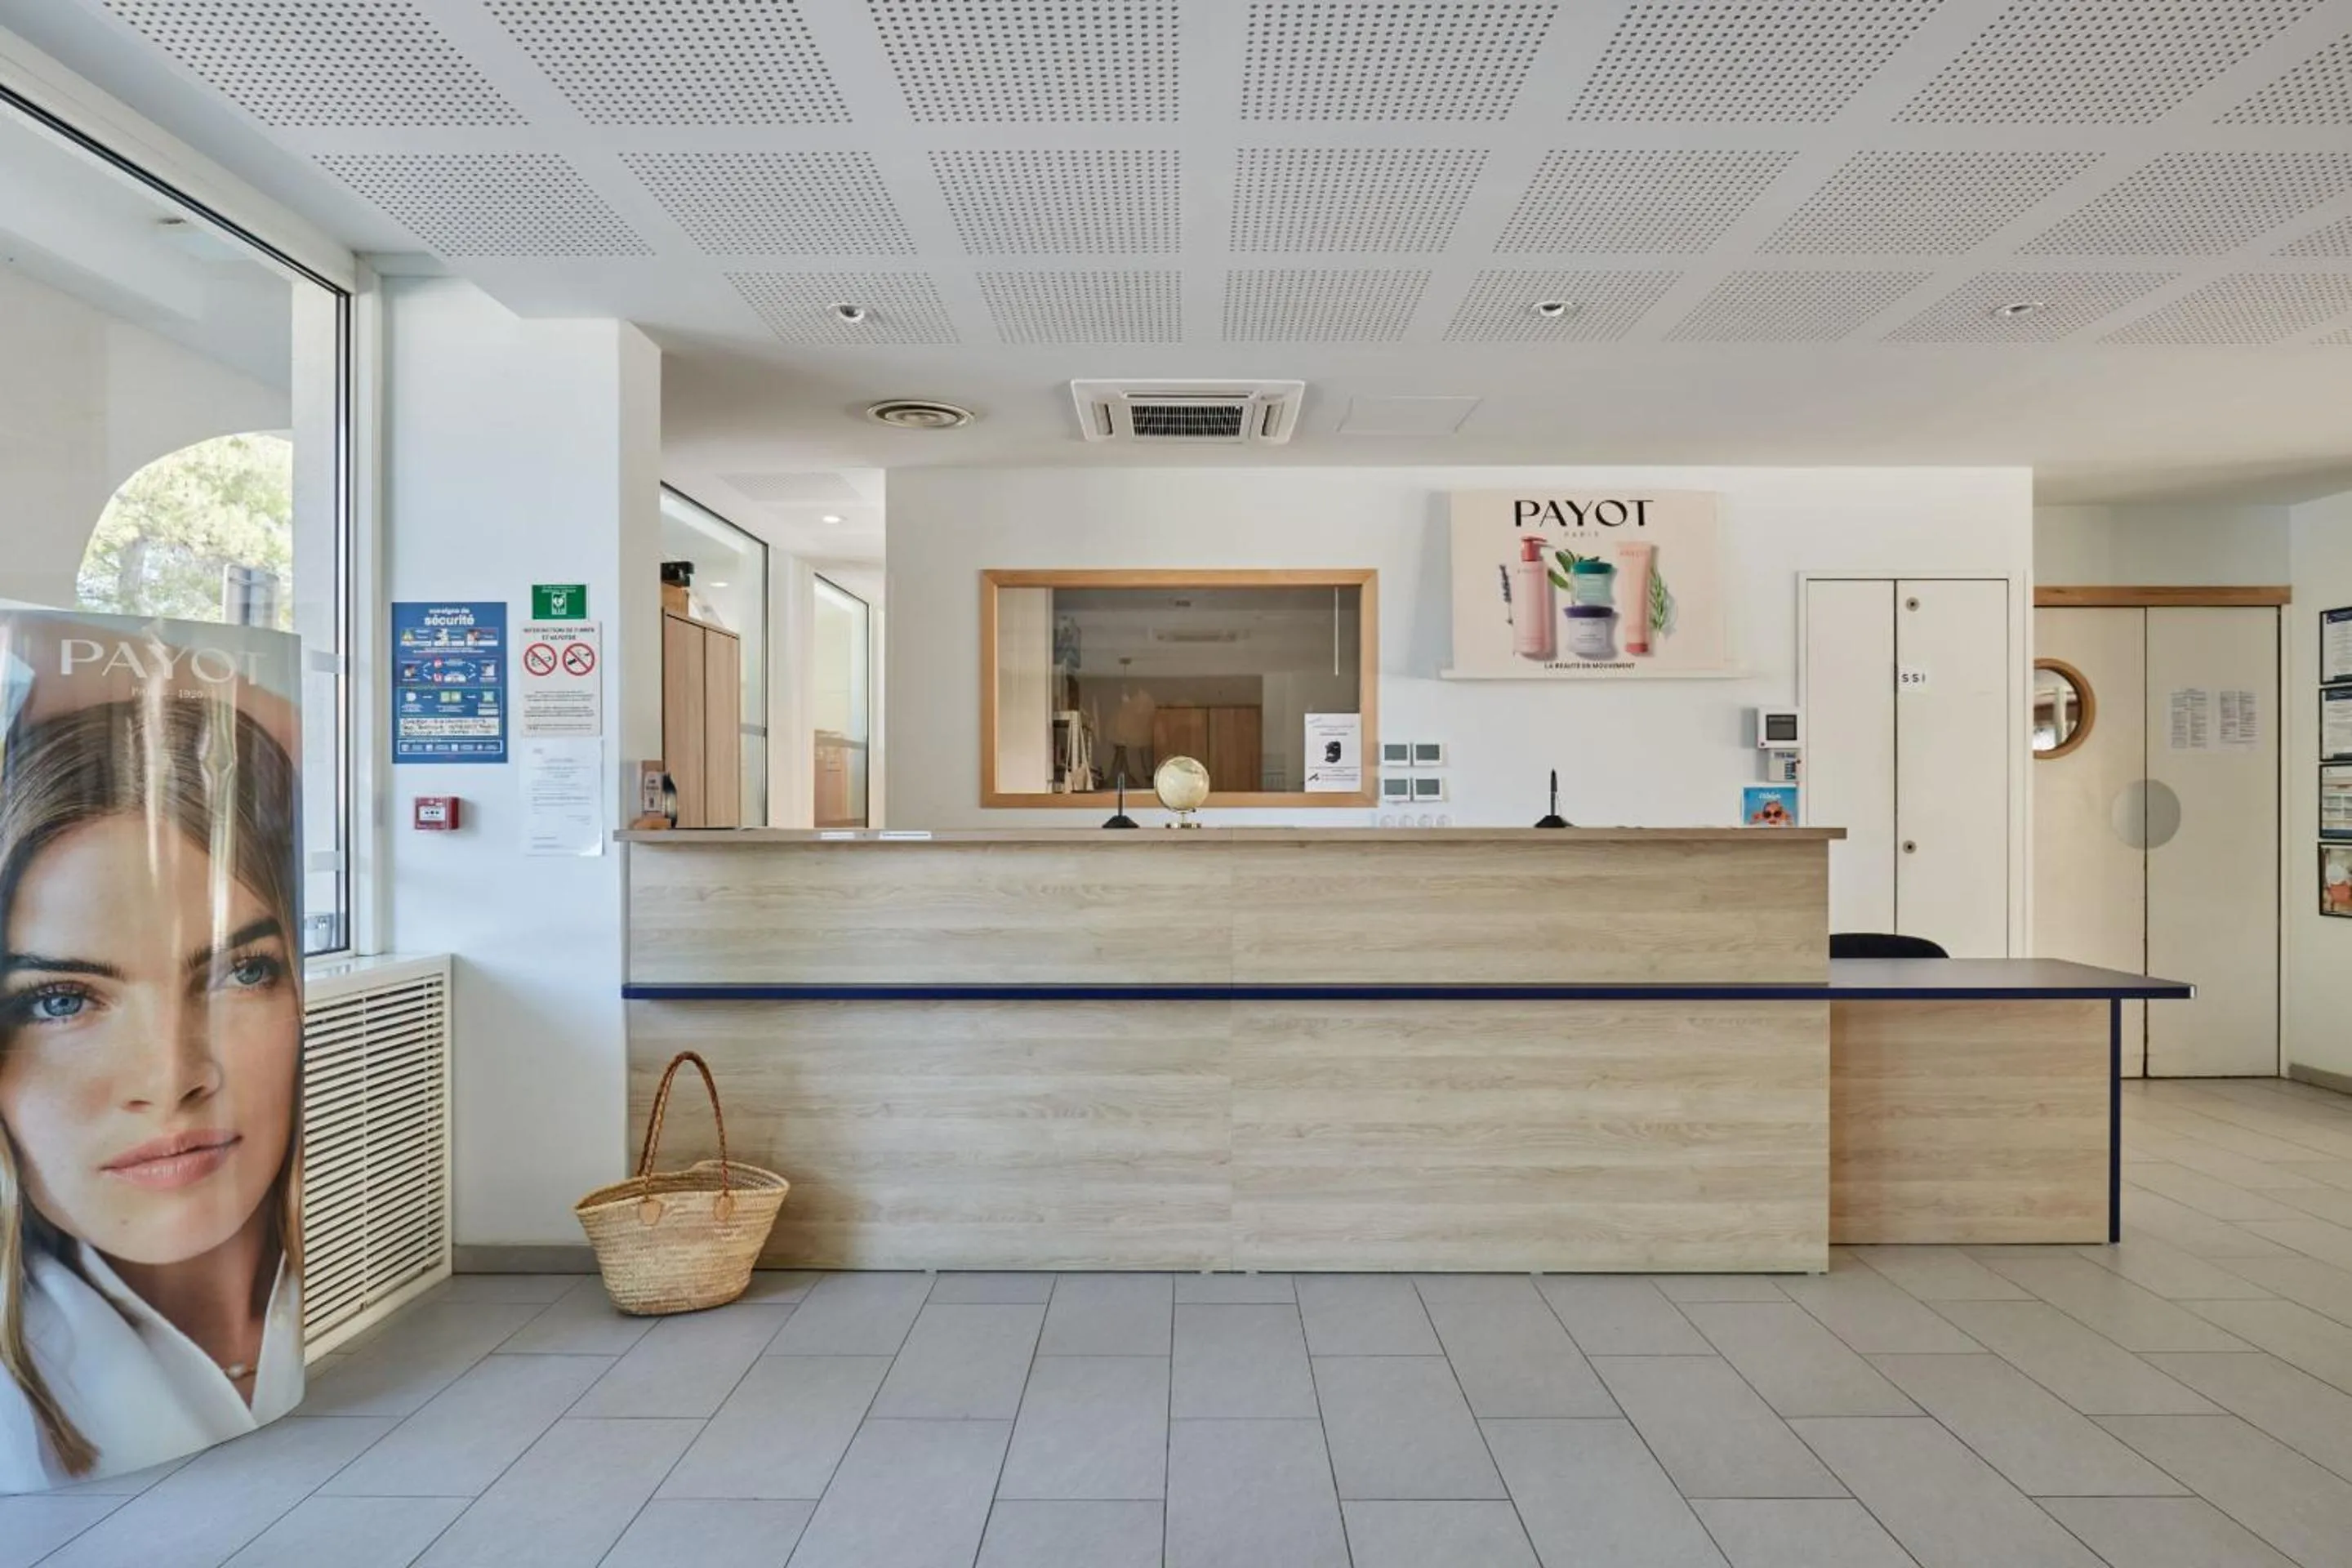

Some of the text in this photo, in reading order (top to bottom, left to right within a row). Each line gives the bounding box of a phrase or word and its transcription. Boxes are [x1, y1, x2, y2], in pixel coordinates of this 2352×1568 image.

[1514, 500, 1654, 527] PAYOT
[424, 614, 474, 626] sécurité
[60, 639, 266, 685] PAYOT
